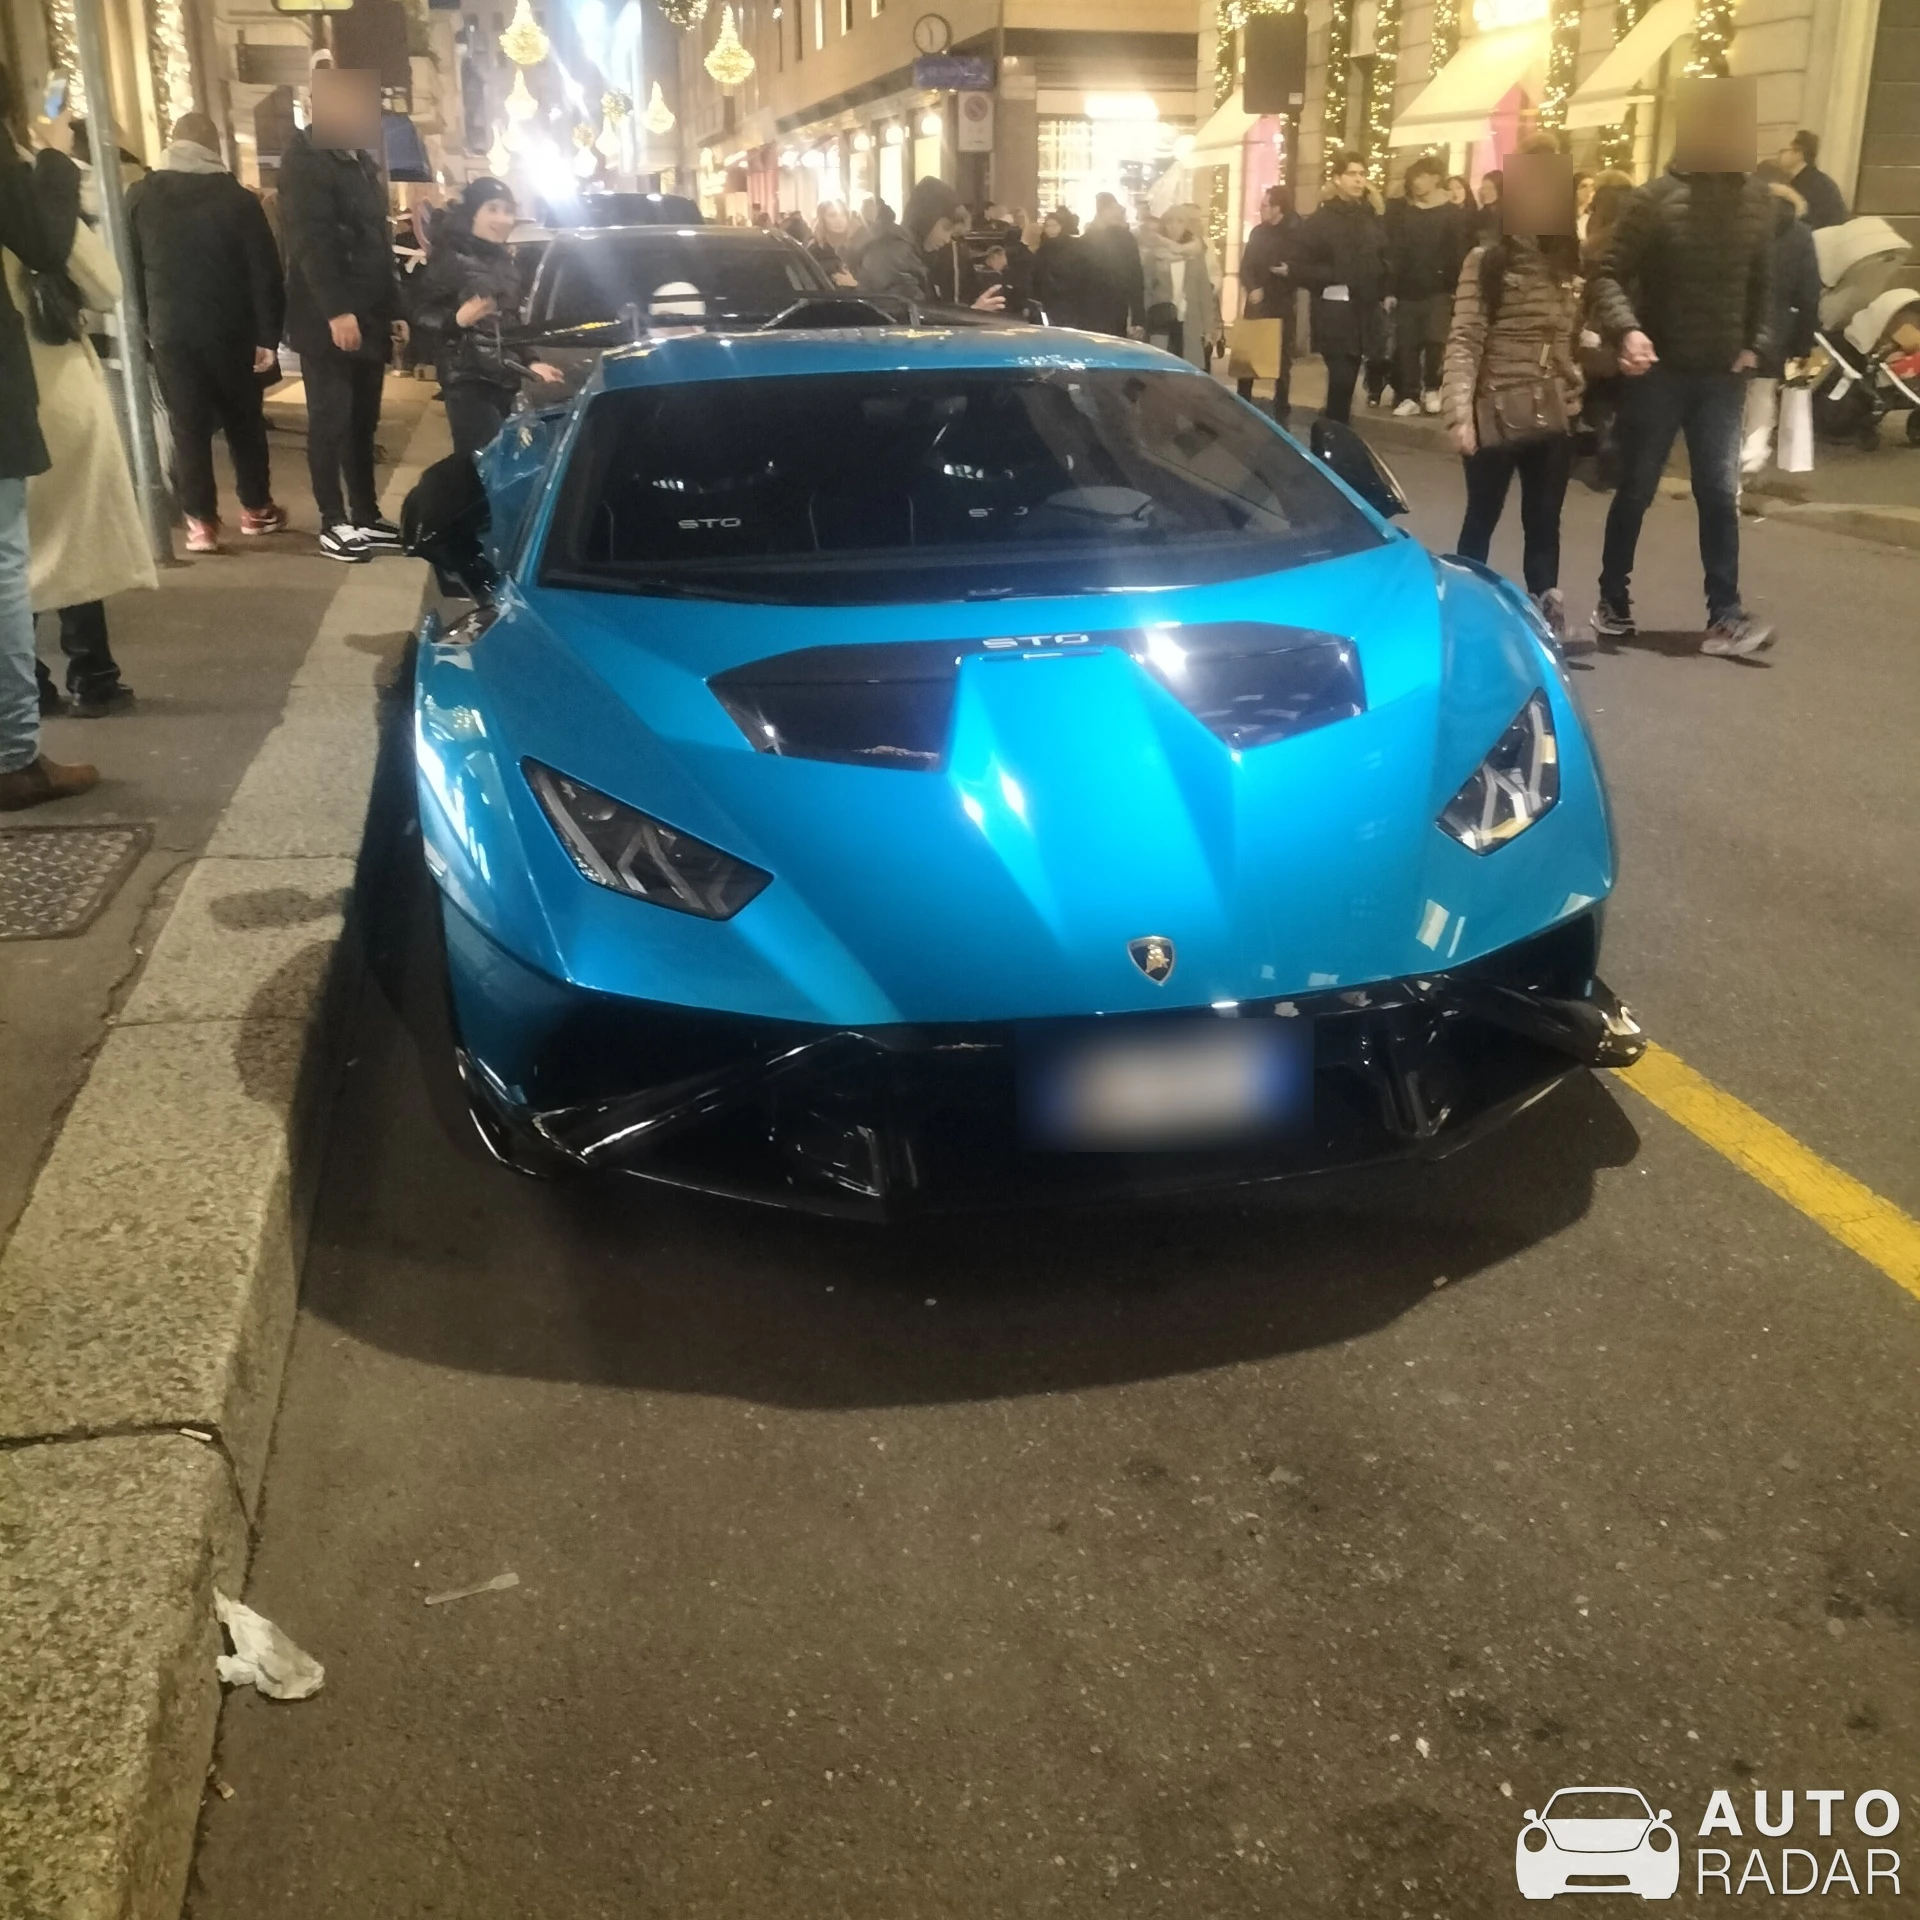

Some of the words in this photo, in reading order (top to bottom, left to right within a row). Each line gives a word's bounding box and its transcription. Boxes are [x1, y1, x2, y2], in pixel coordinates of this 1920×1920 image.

[968, 505, 1028, 518] SO
[677, 517, 742, 530] STO
[982, 633, 1090, 649] STO
